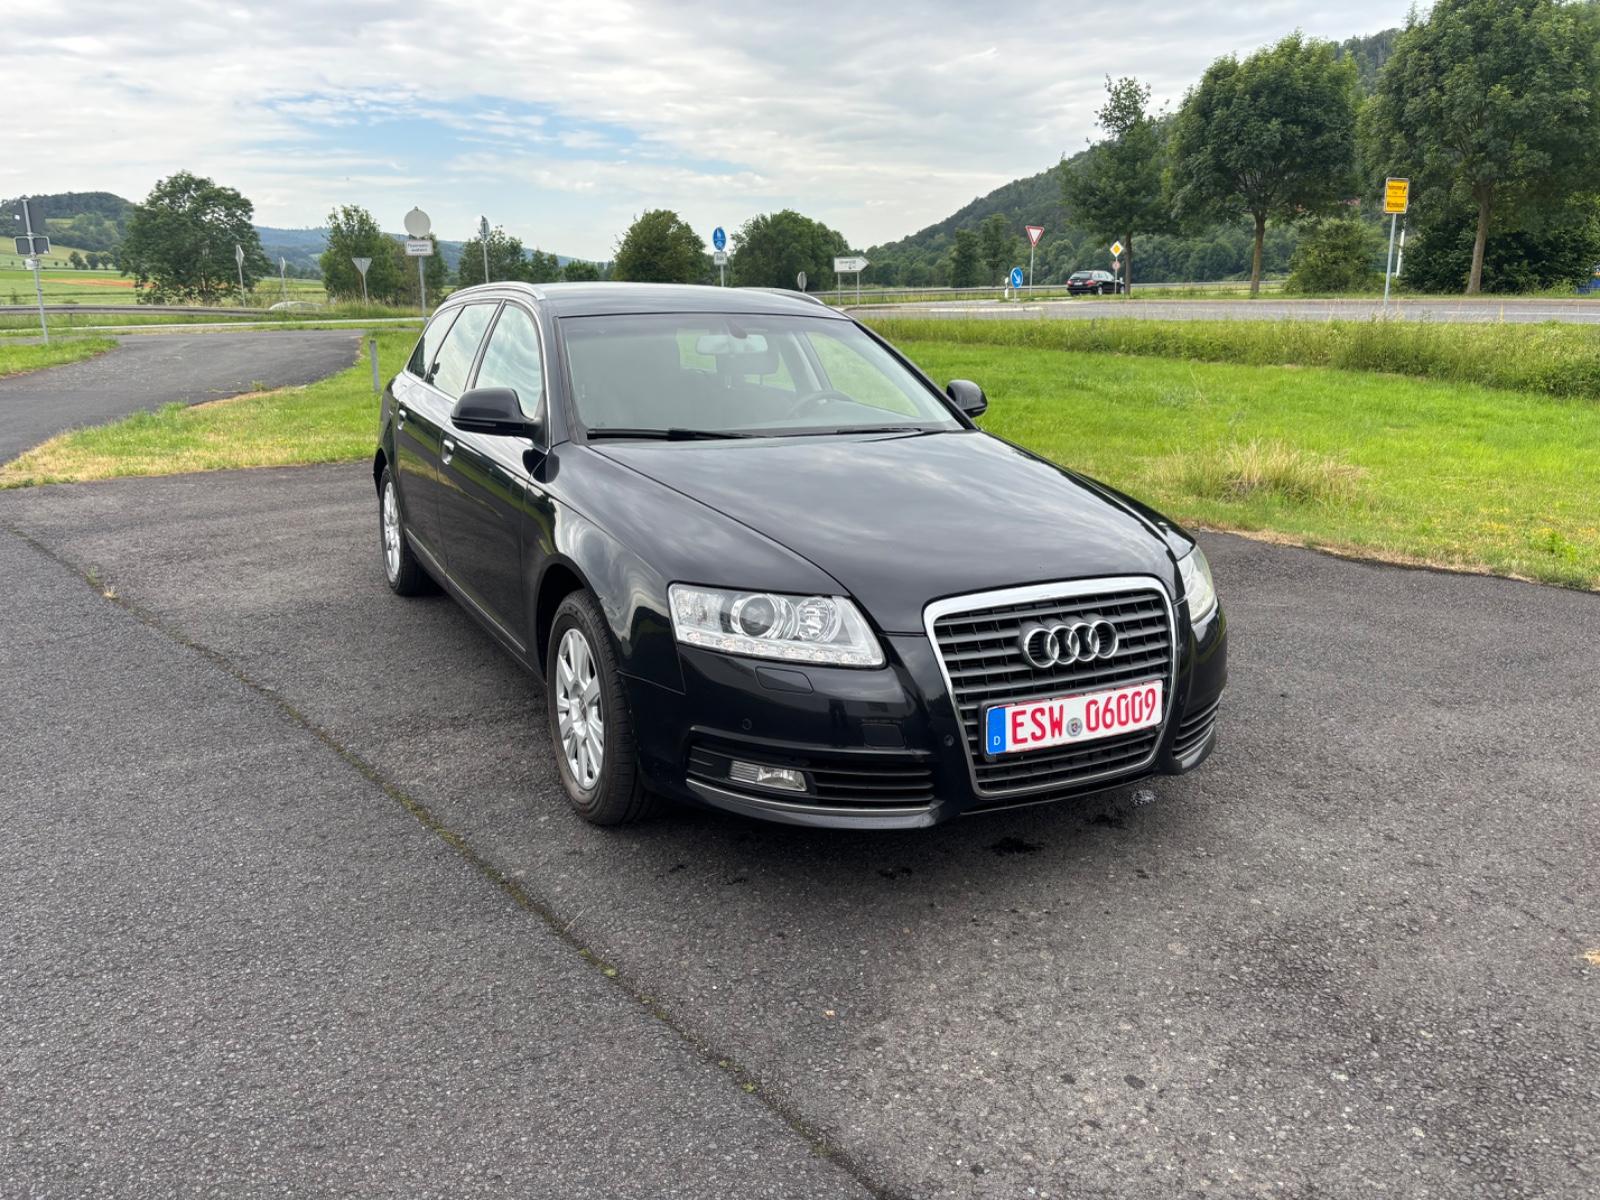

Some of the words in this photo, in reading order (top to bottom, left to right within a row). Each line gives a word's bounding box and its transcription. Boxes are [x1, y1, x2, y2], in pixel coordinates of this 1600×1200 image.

[993, 735, 1001, 746] D
[1011, 704, 1064, 745] ESW
[1085, 687, 1156, 732] 06009
